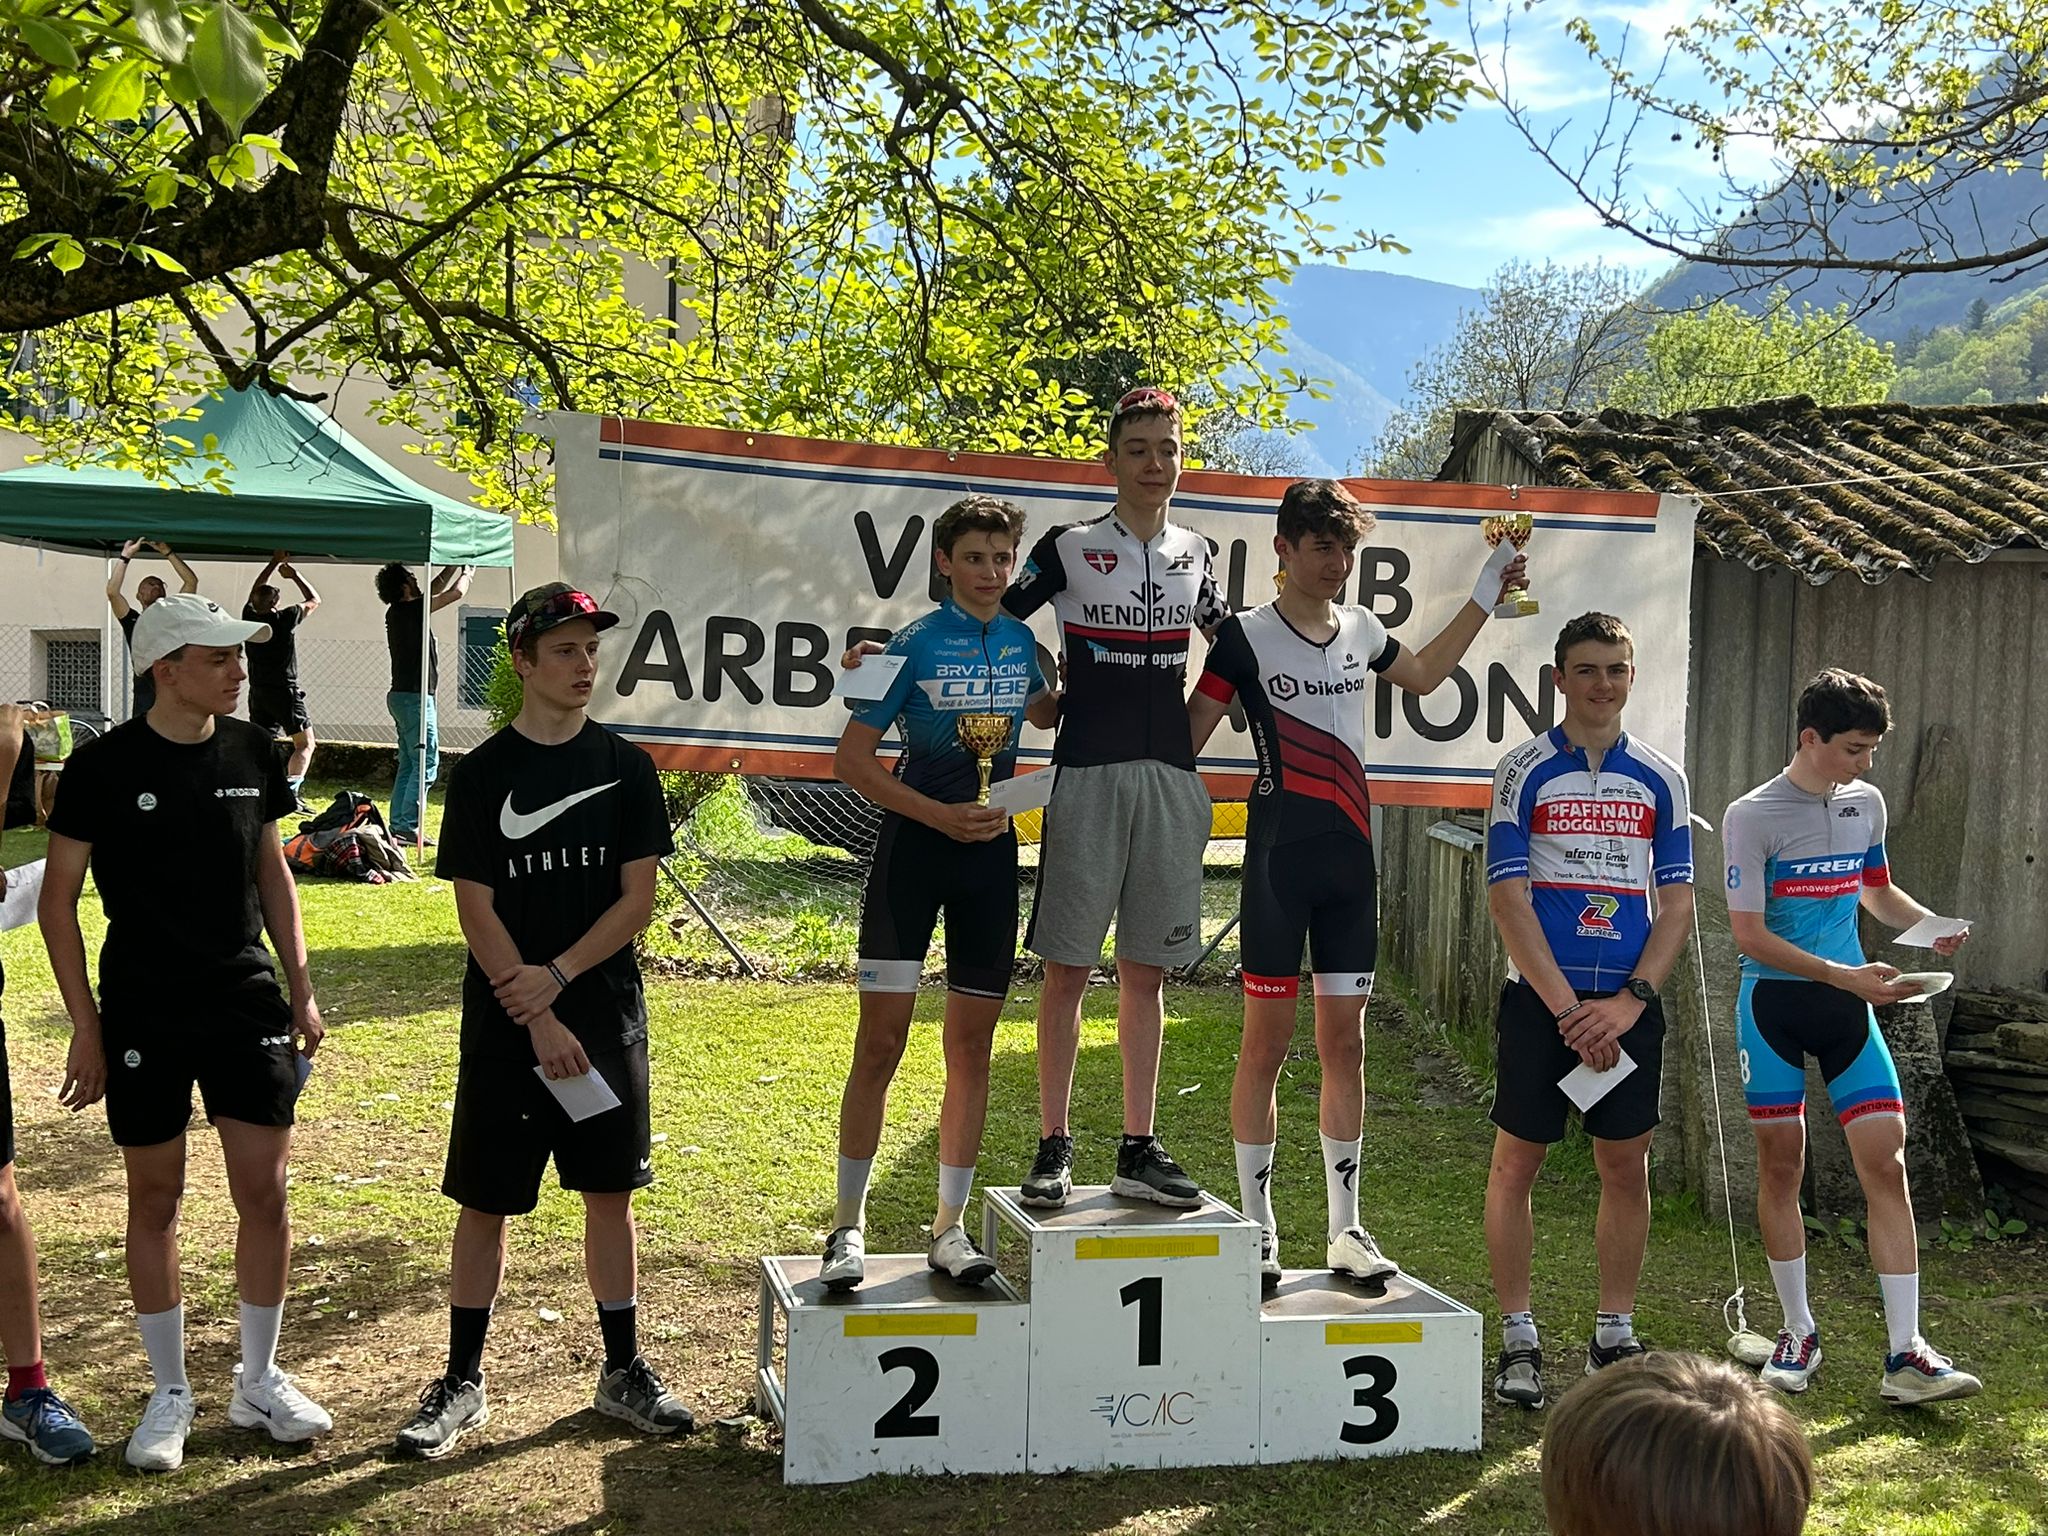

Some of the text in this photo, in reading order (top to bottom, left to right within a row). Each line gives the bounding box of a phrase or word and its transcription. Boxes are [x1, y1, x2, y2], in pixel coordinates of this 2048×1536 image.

[1083, 603, 1193, 627] MENDRISI
[936, 663, 1027, 677] BRV RACING
[941, 680, 1028, 697] CUBE
[1304, 678, 1365, 696] bikebox
[1548, 802, 1644, 820] PFAFFNAU
[1547, 818, 1641, 835] ROGGLISWIL
[508, 847, 606, 878] ATHLET
[1790, 858, 1863, 874] TREK
[1119, 1277, 1163, 1366] 1
[874, 1346, 940, 1438] 2
[1339, 1355, 1399, 1444] 3
